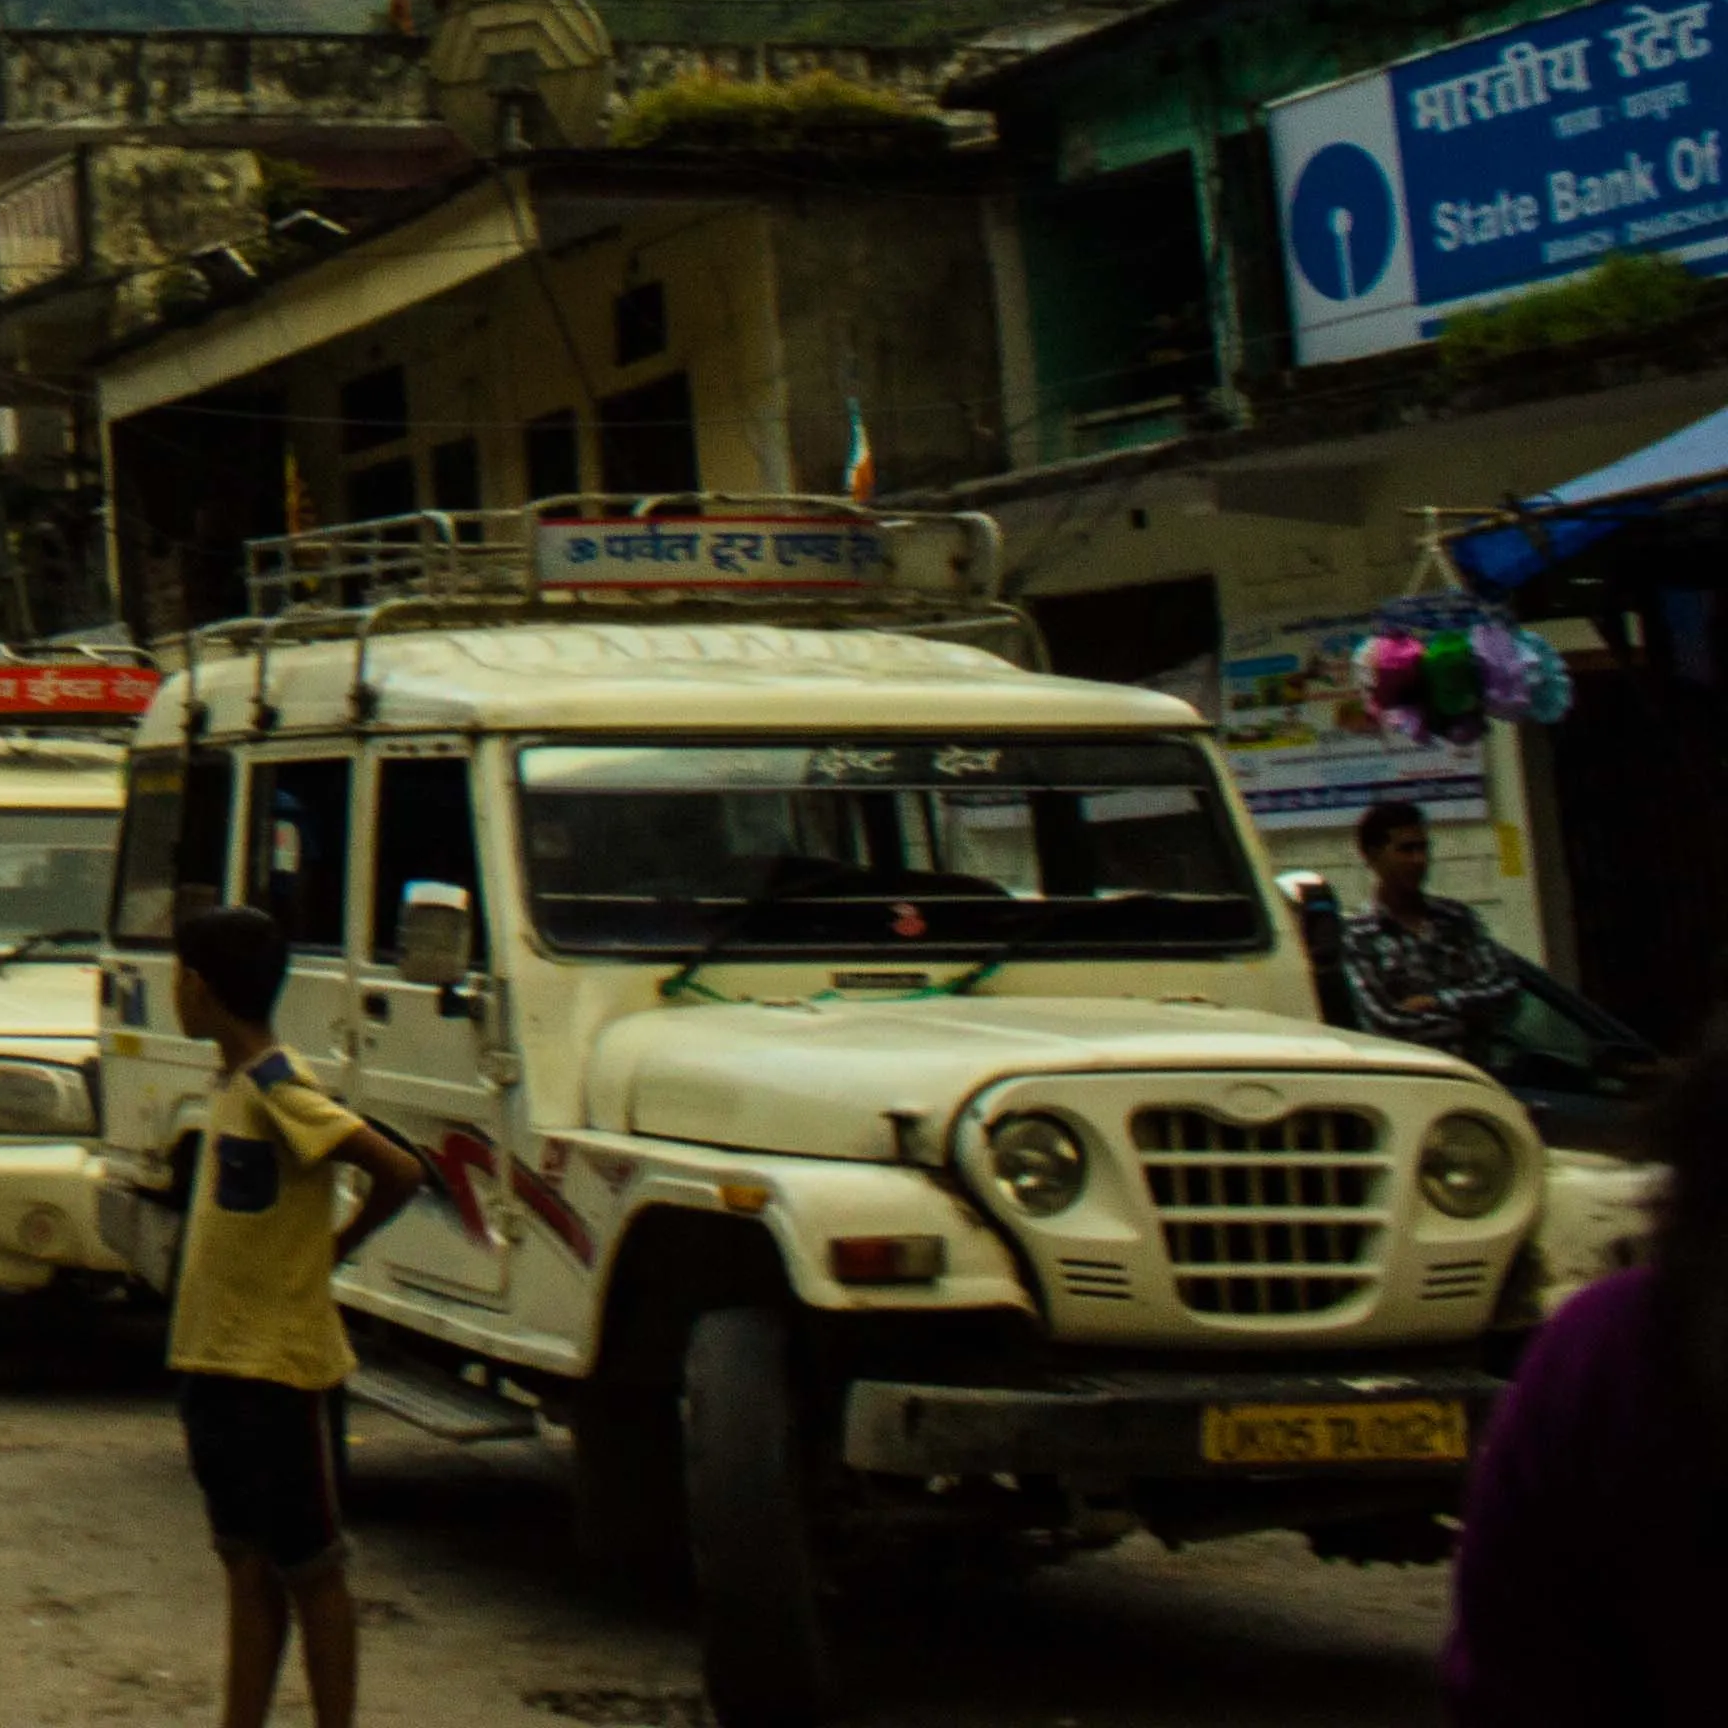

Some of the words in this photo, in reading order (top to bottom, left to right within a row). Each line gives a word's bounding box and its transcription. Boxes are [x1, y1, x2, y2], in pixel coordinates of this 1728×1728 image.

[1408, 38, 1592, 132] भारतीय
[1602, 1, 1715, 78] स्टेट
[1433, 189, 1540, 252] State
[1547, 151, 1660, 225] Bank
[1668, 130, 1721, 192] Of
